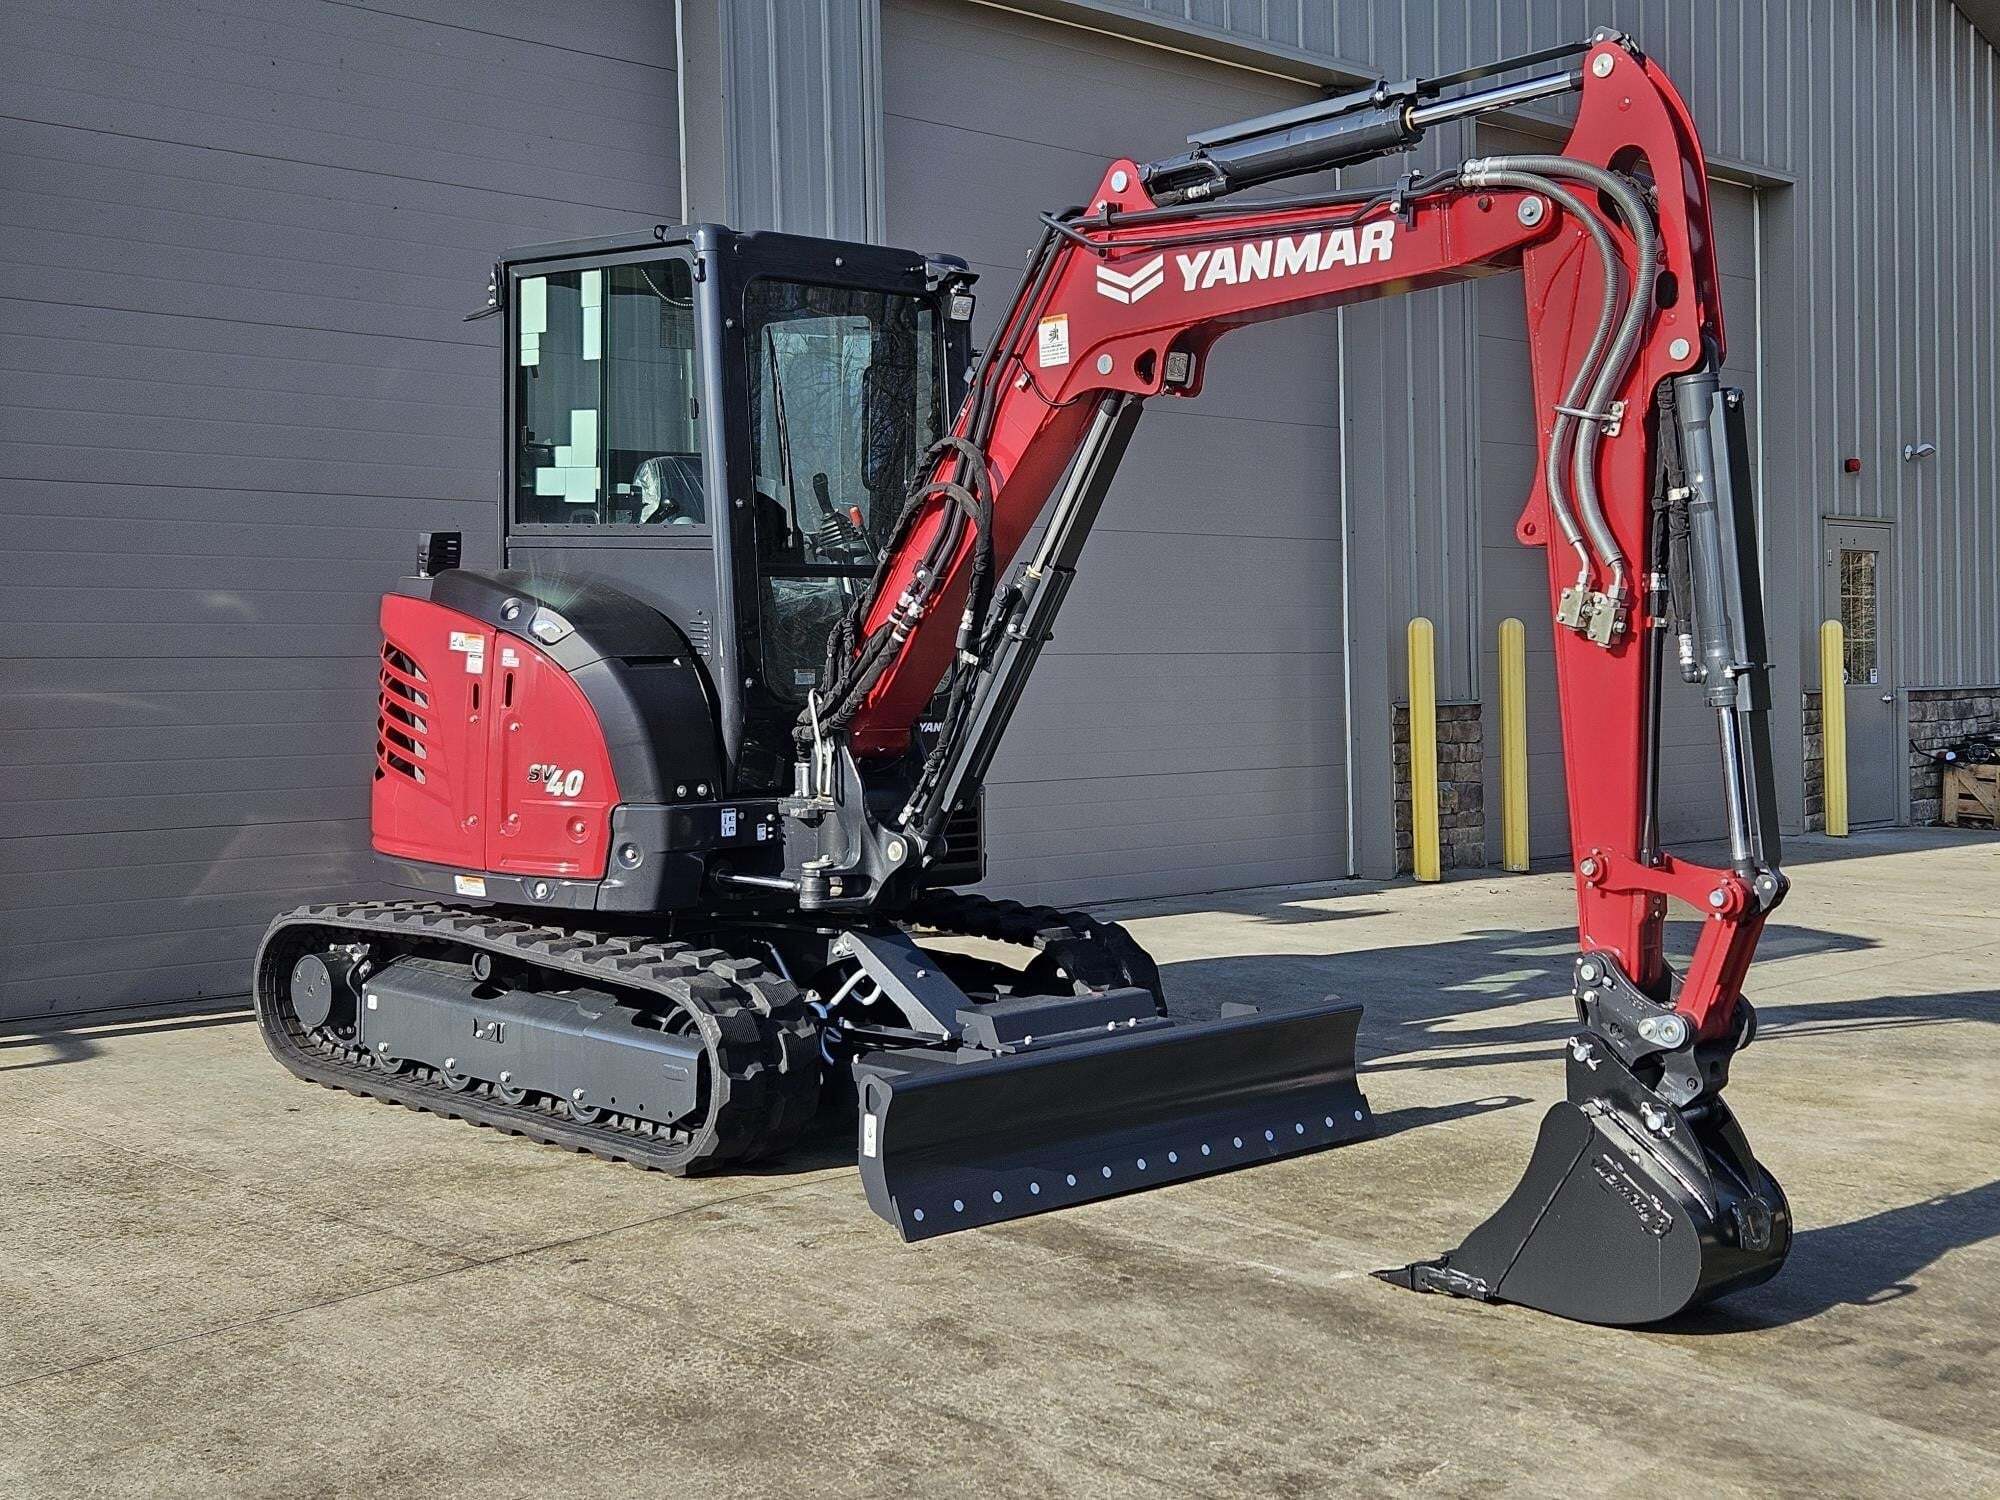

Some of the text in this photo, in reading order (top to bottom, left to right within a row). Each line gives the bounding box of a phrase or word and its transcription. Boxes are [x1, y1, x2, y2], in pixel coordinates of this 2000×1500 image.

[1175, 220, 1395, 292] YANMAR
[920, 722, 942, 733] YAN
[527, 763, 585, 797] SV40
